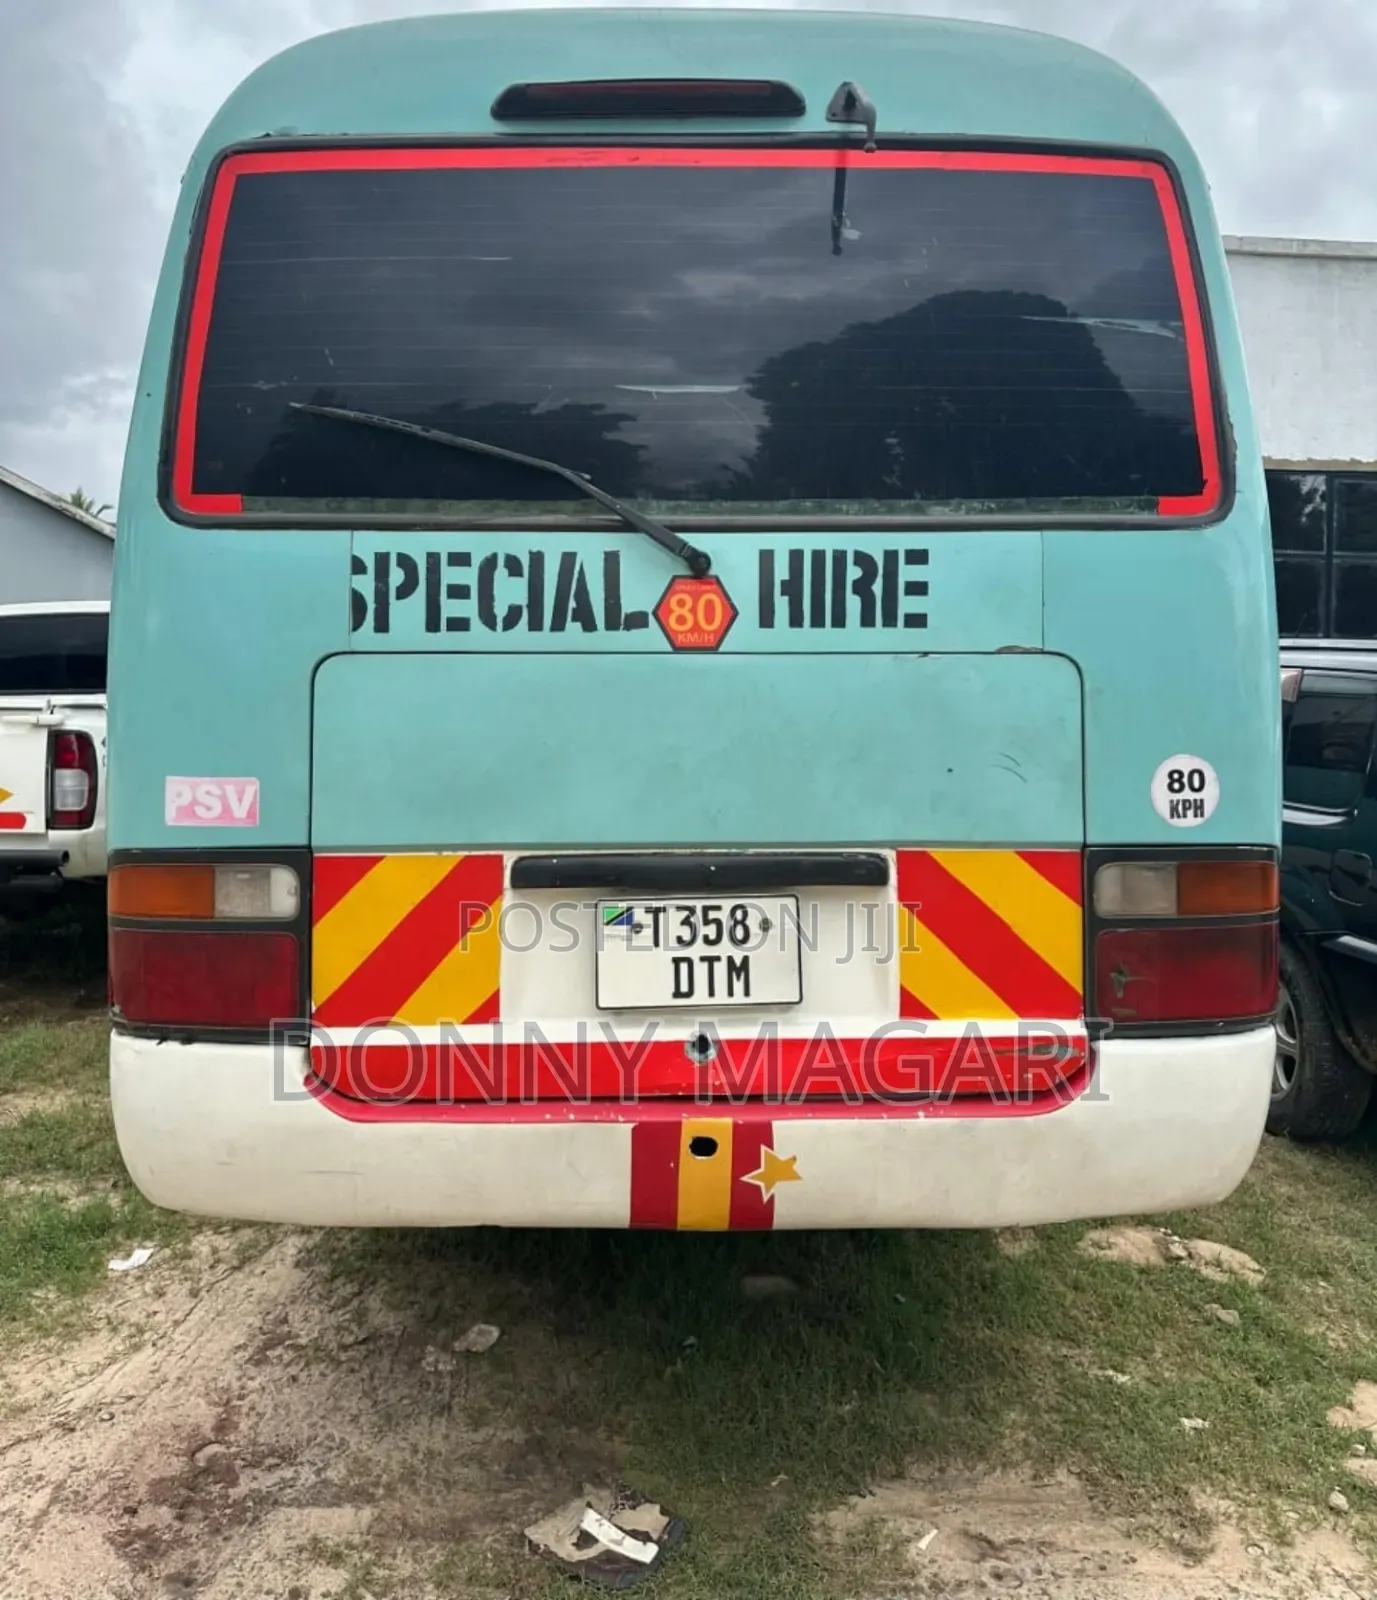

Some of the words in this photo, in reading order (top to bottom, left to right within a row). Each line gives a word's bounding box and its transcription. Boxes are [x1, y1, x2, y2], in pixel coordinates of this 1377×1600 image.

[759, 548, 929, 628] HIRE
[668, 593, 722, 632] 80
[678, 632, 714, 643] KM/H
[1167, 768, 1206, 794] 80
[165, 784, 257, 819] PSV
[1169, 798, 1205, 820] KPH
[644, 903, 751, 949] T358
[672, 955, 751, 1000] DTM
